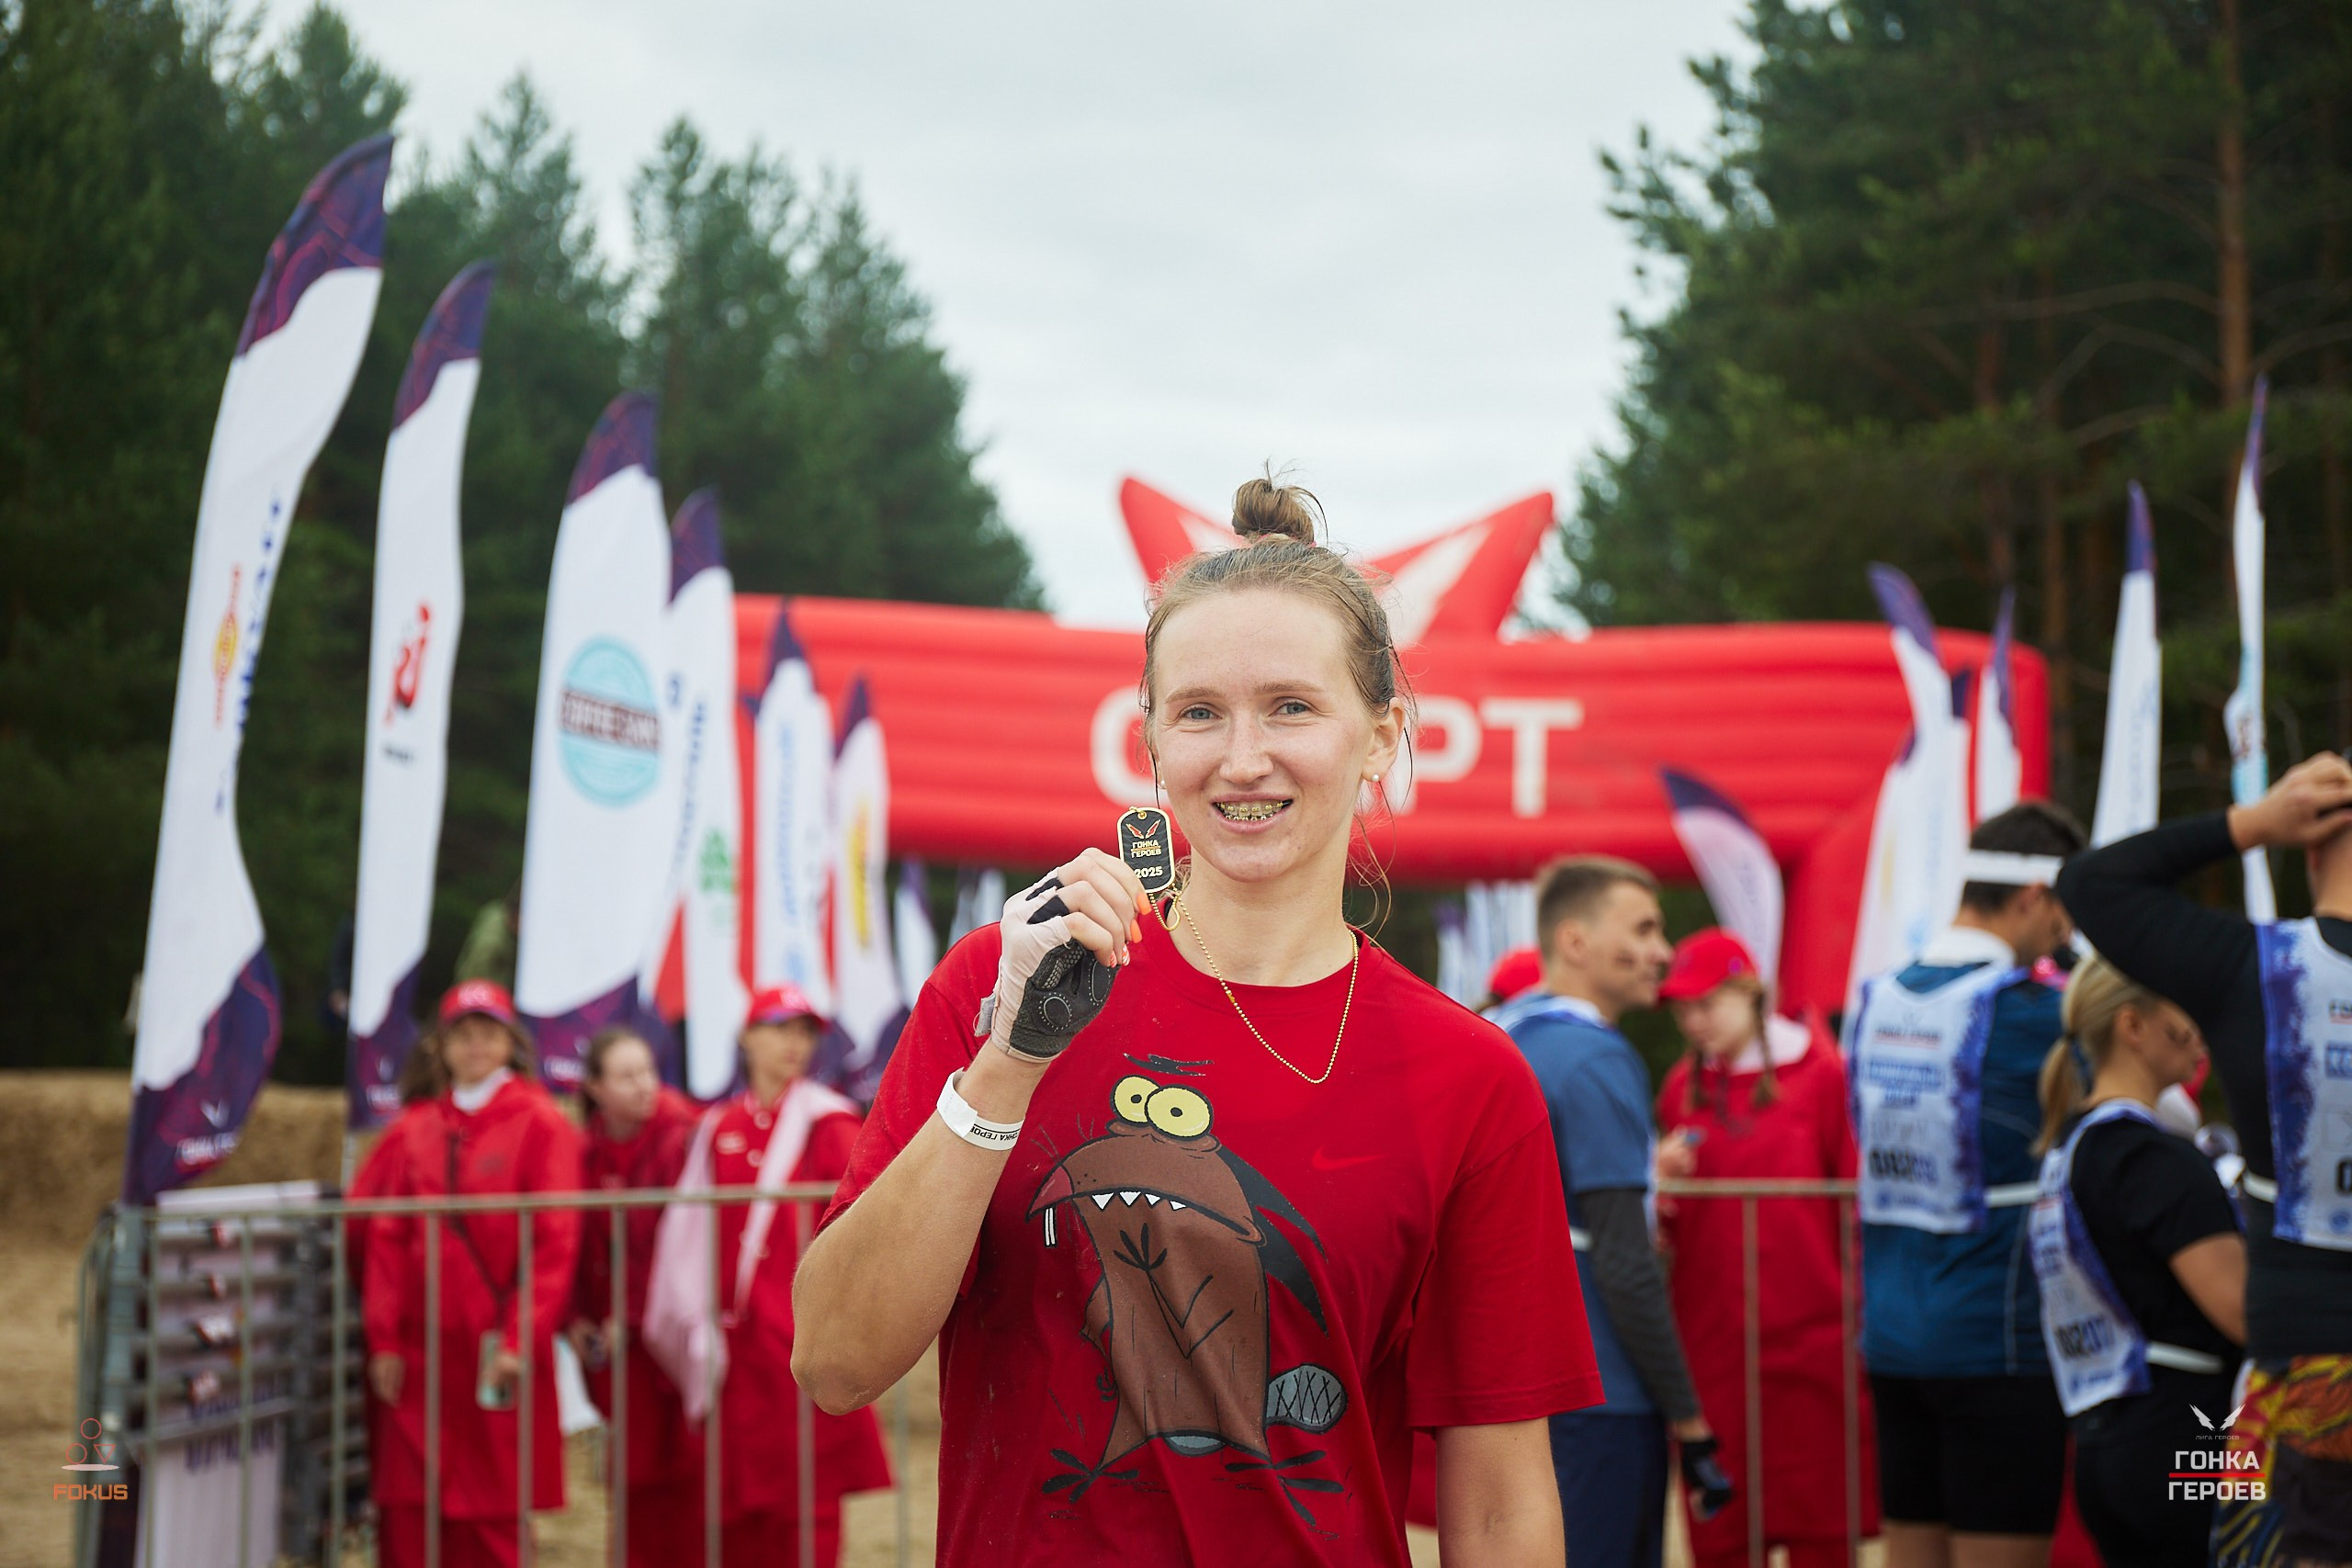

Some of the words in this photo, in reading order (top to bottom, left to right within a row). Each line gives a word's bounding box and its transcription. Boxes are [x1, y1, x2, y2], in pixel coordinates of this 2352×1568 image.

[1091, 686, 1584, 818] СРТ
[1132, 840, 1159, 849] ГОНКА
[1131, 848, 1162, 858] ГЕРОЕВ
[1134, 866, 1163, 878] 2025
